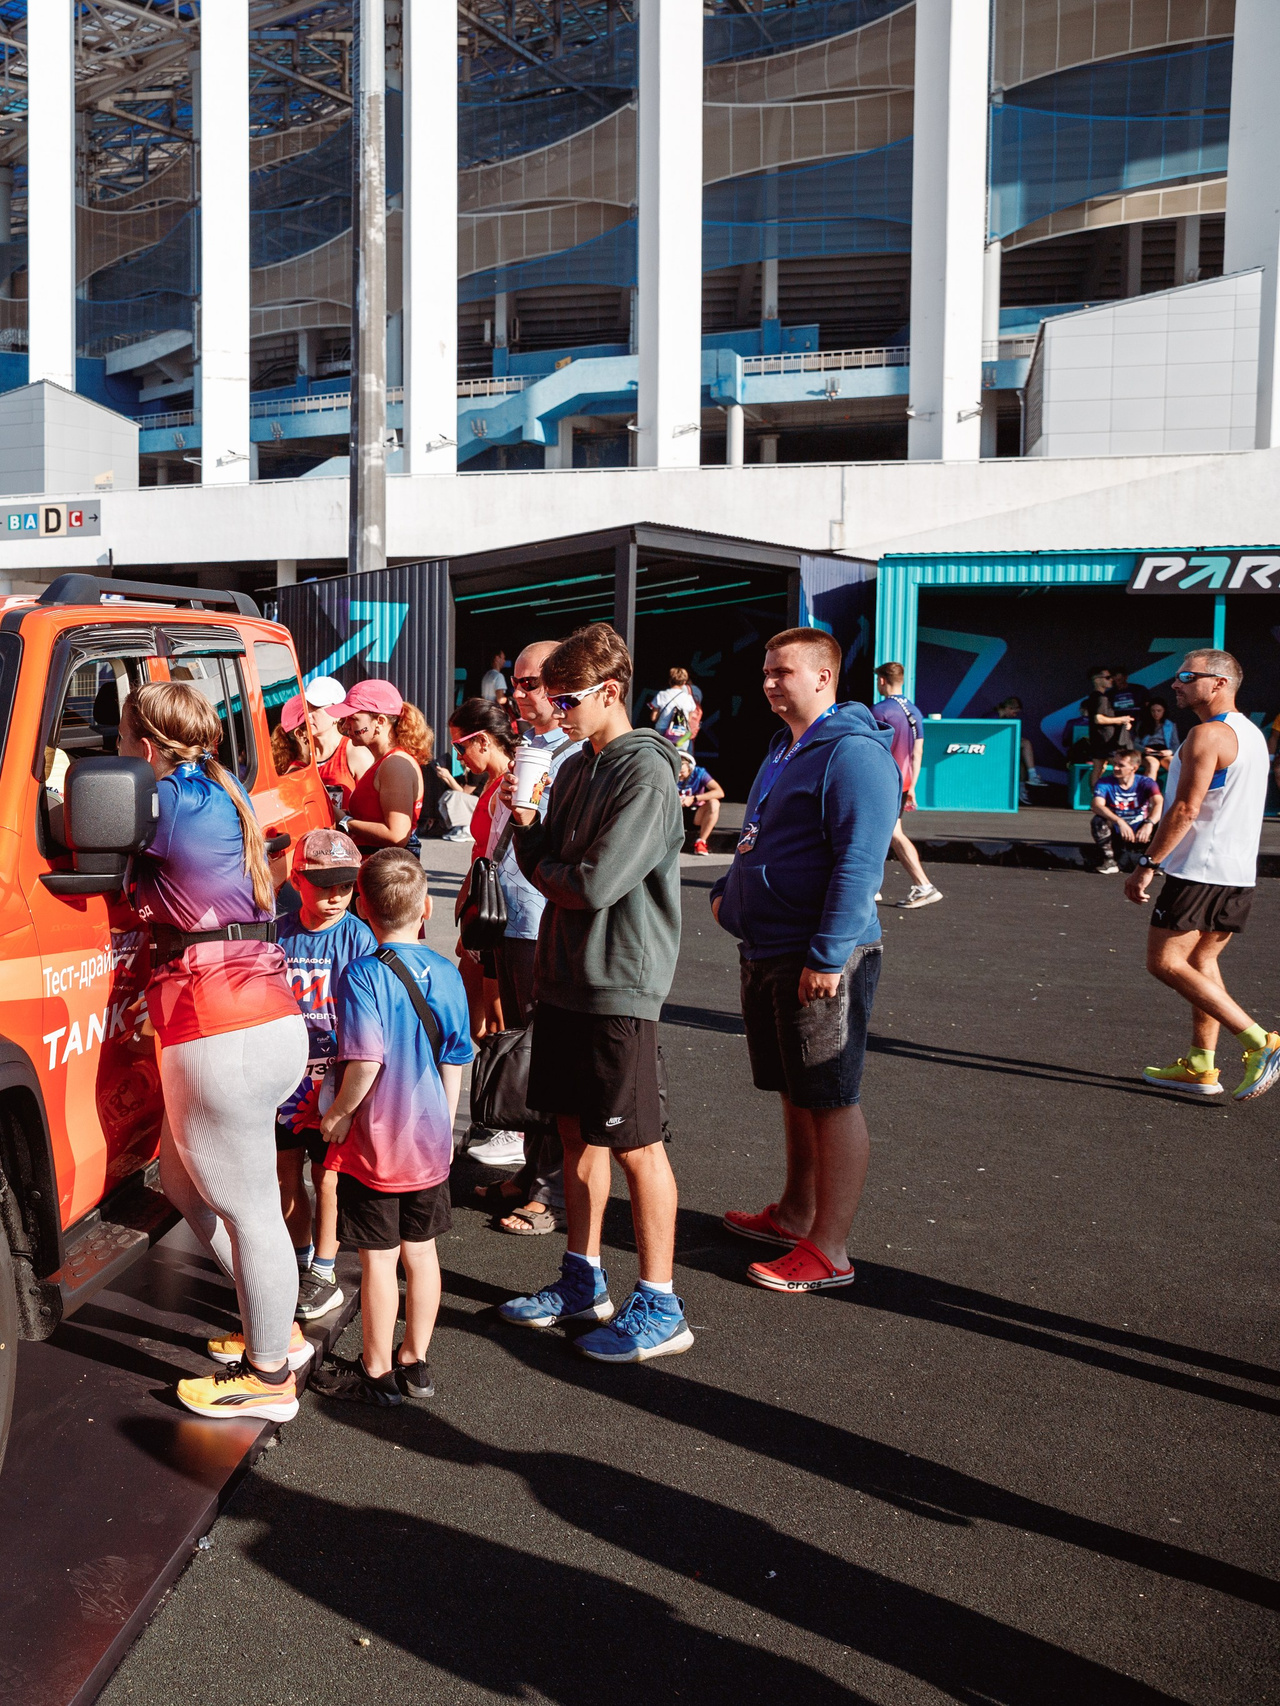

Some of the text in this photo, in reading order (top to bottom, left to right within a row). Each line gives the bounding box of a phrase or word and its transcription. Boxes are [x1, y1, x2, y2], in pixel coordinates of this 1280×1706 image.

[10, 508, 81, 533] B A D C
[1132, 556, 1280, 590] PAR
[43, 944, 118, 997] Тест-драйв
[43, 997, 130, 1071] TANK
[787, 1281, 822, 1289] crocs
